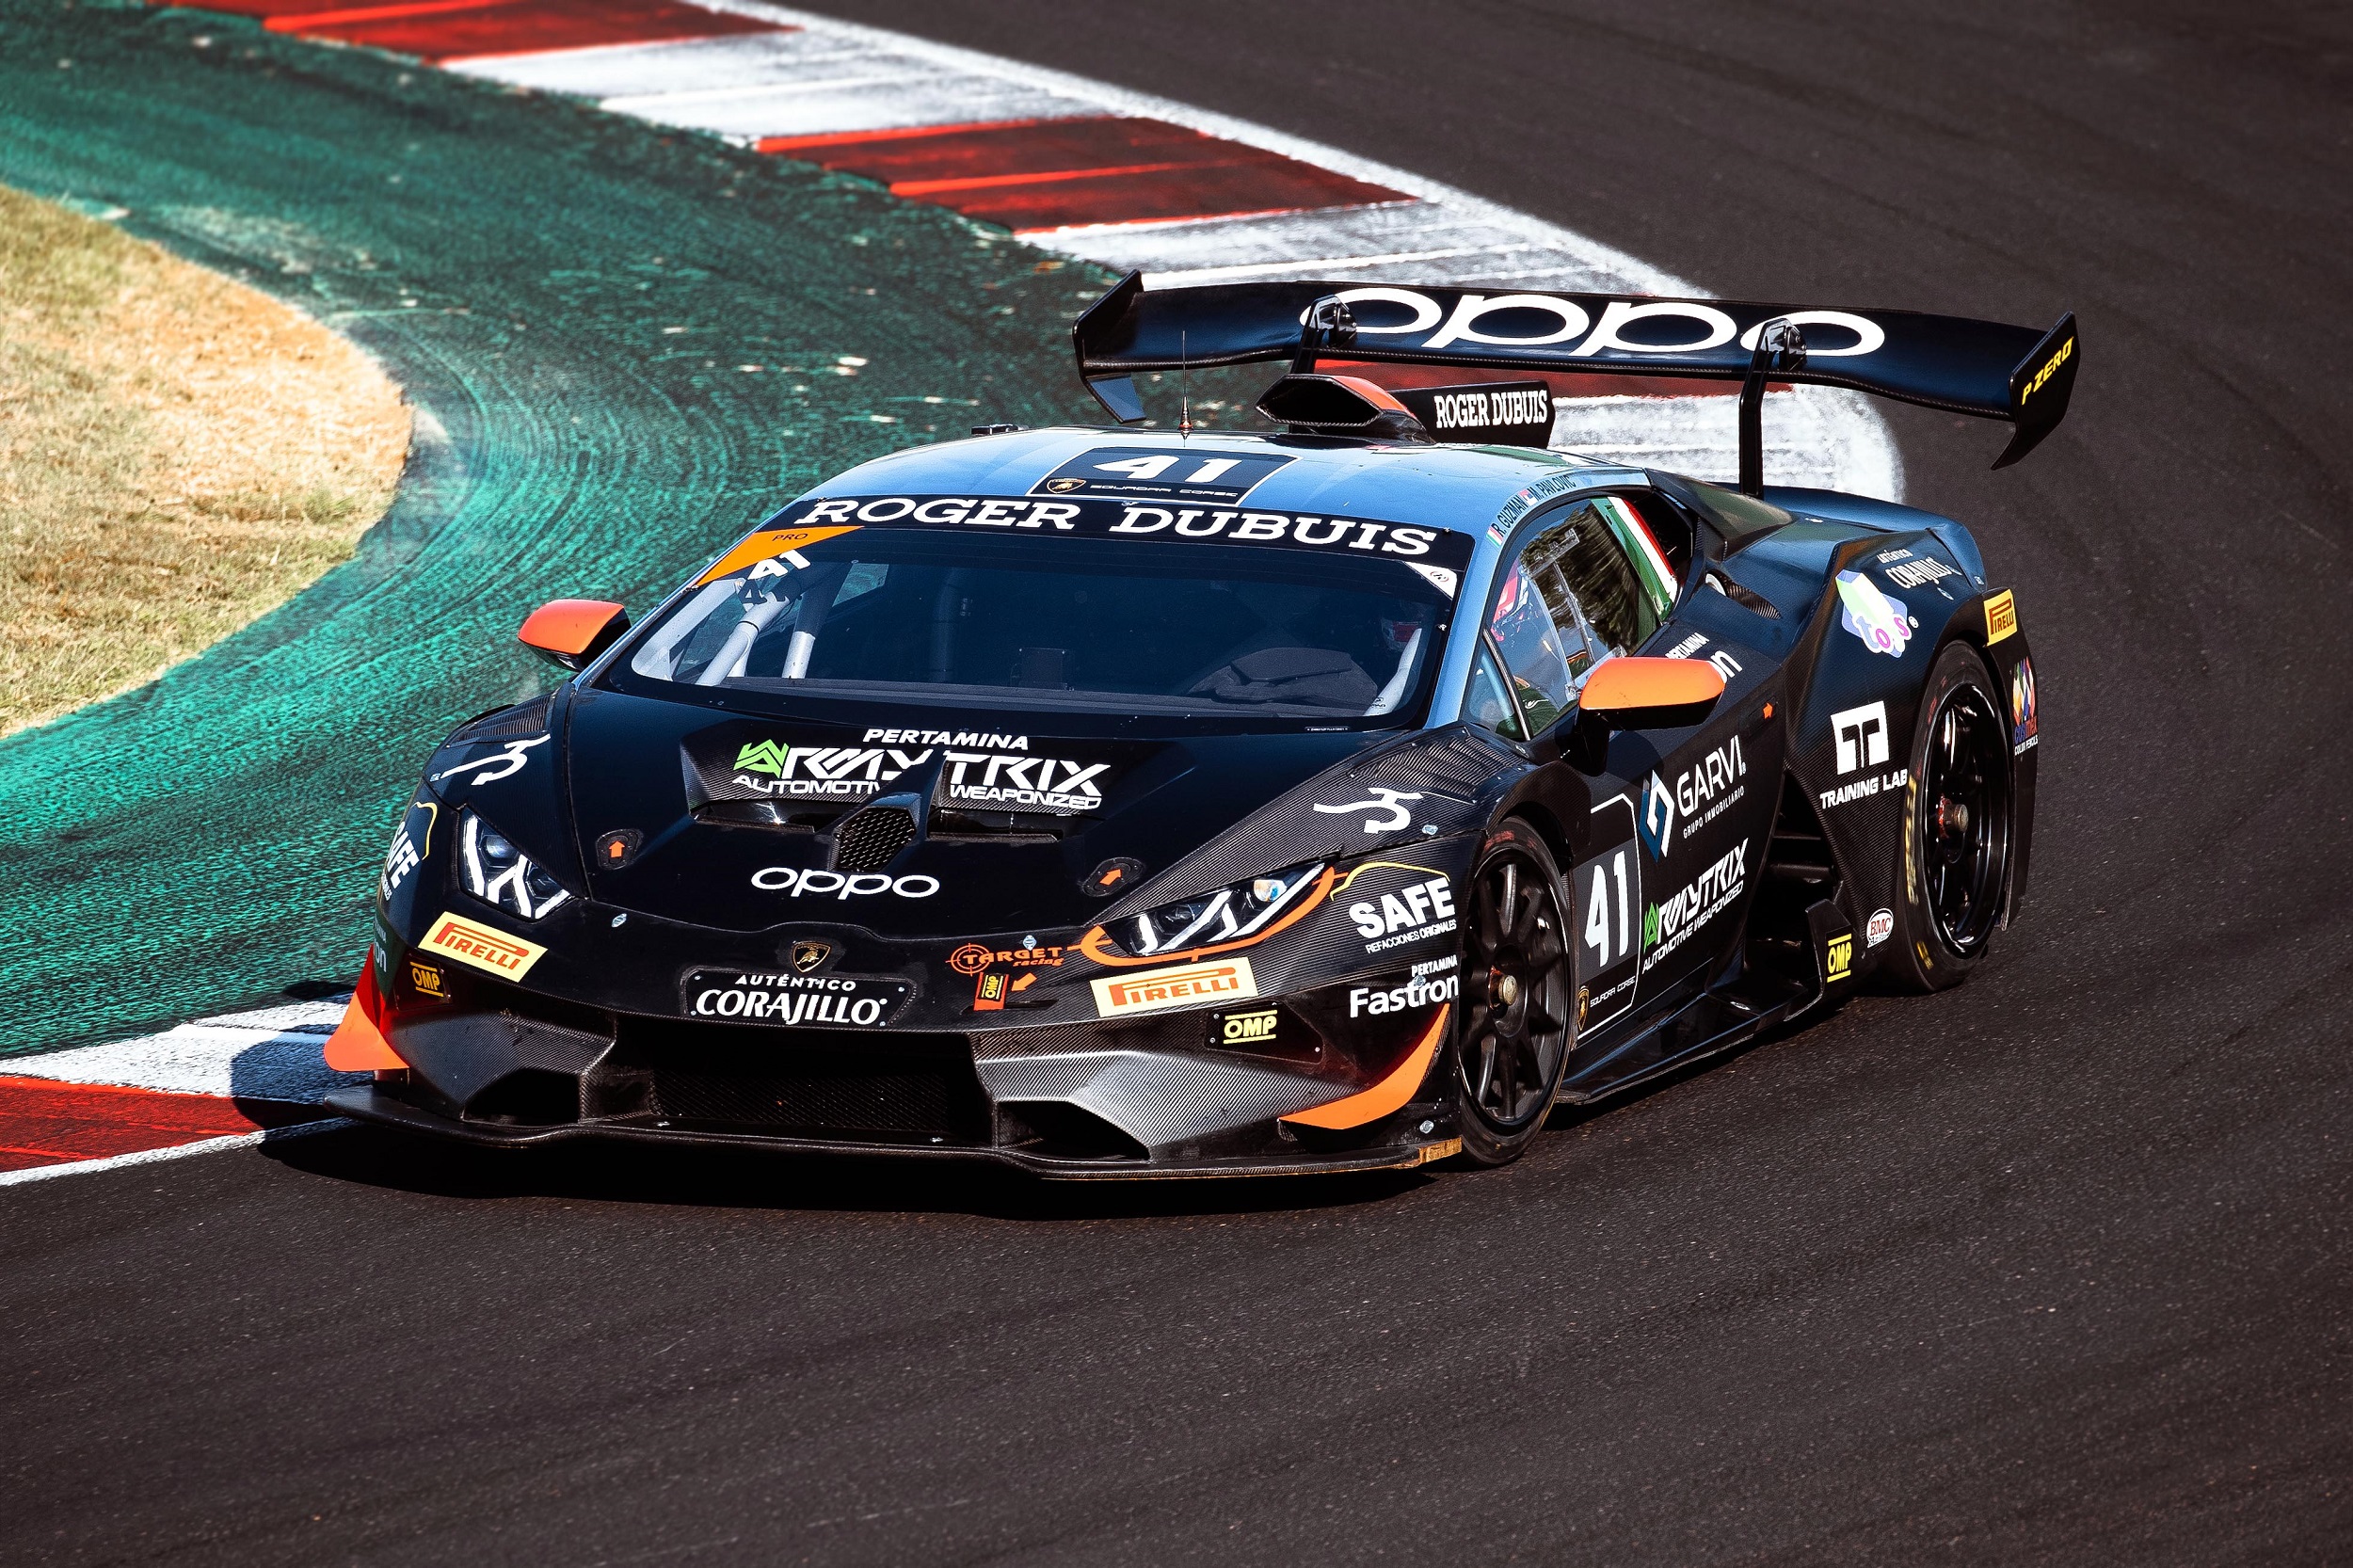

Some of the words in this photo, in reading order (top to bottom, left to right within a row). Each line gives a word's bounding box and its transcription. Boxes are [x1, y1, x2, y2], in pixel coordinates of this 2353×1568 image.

[1299, 287, 1885, 357] oppo
[2021, 381, 2032, 406] P
[2033, 336, 2074, 392] ZERO
[1433, 392, 1489, 429] ROGER
[1490, 390, 1548, 426] DUBUIS
[1092, 455, 1243, 483] 41
[793, 498, 1080, 531] ROGER
[1109, 507, 1438, 555] DUBUIS
[1497, 493, 1529, 529] GUZMAN
[772, 533, 808, 542] PRO
[746, 549, 811, 577] 41
[1988, 598, 2014, 635] PIRELLI
[863, 728, 1029, 751] PERTAMINA
[732, 774, 881, 795] AUTOMOTI
[950, 784, 1102, 810] WEAPONIZED
[1819, 776, 1880, 809] TRAINING
[1882, 769, 1909, 792] LAB
[1683, 816, 1704, 840] GRUPO
[751, 867, 940, 901] oppo
[1349, 876, 1456, 939] SAFE
[1584, 850, 1629, 968] 41
[1365, 930, 1420, 954] REFACCIONES
[1419, 919, 1458, 939] ORIGINALES
[1641, 921, 1694, 975] AUTOMOTIVE
[1693, 879, 1744, 932] WEAPONIZED
[1870, 917, 1892, 936] BMC
[433, 921, 529, 970] PIRELLI
[962, 947, 1063, 966] TARGET
[1012, 957, 1064, 968] racing
[1827, 942, 1852, 975] OMP
[411, 968, 440, 991] OMP
[735, 973, 856, 992] AUTÉNTICO
[1412, 954, 1458, 978] PERTAMINA
[984, 975, 999, 999] OMP
[1108, 967, 1240, 1007] PIRELLI
[1350, 974, 1460, 1019] Fastron
[696, 989, 888, 1026] CORAJILLO
[1224, 1015, 1277, 1039] OMP
